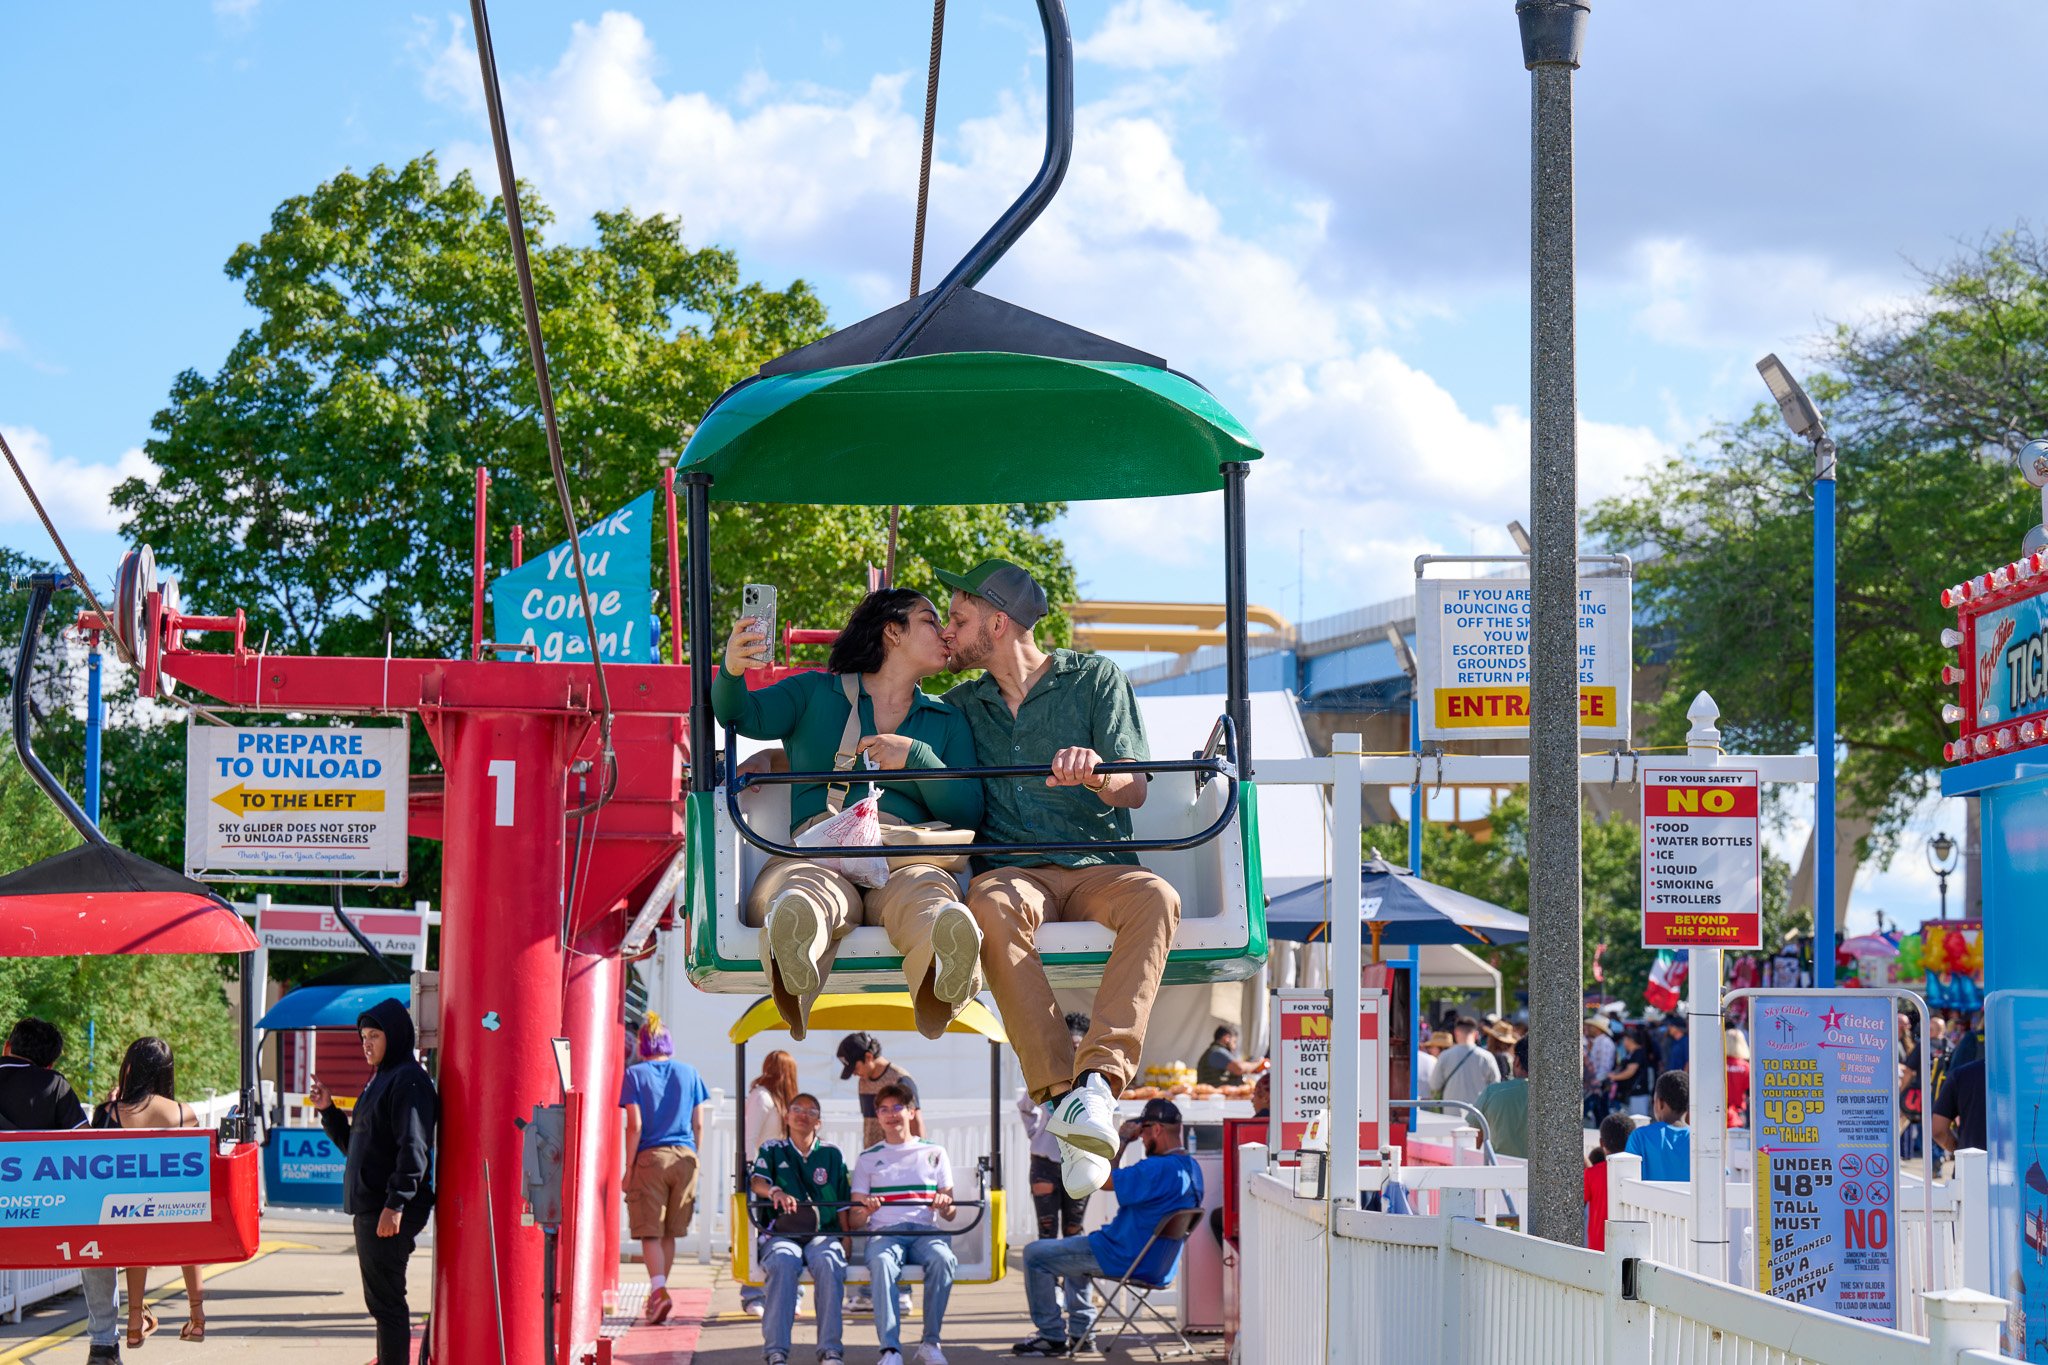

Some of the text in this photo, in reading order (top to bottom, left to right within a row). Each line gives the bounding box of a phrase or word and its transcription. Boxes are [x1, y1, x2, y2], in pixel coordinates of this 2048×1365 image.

[547, 545, 610, 580] You
[1458, 590, 1470, 600] IF
[1473, 590, 1501, 600] YOU
[522, 589, 621, 620] Come
[1444, 604, 1518, 614] BOUNCING
[1457, 617, 1483, 628] OFF
[1486, 617, 1513, 628] THE
[1484, 631, 1513, 641] YOU
[1453, 645, 1524, 655] ESCORTED
[1457, 659, 1527, 669] GROUNDS
[1458, 672, 1512, 683] RETURN
[238, 733, 363, 755] PREPARE
[216, 757, 382, 779] TO UNLOAD
[1658, 775, 1678, 783] FOR
[1680, 775, 1706, 783] YOUR
[487, 760, 516, 826] 1
[240, 793, 356, 808] TO THE LEFT
[1667, 789, 1735, 813] NO
[218, 823, 377, 833] SKY GLIDER DOES NOT STOP
[1656, 823, 1689, 832] FOOD
[226, 833, 369, 844] TO UNLOAD PASSENGERS
[1656, 836, 1753, 847] WATER BOTTLES
[238, 851, 356, 862] Thank You For Your Cooperation
[1656, 850, 1674, 860] ICE
[1656, 865, 1697, 875] LIQUID
[1656, 880, 1714, 889] SMOKING
[1656, 895, 1721, 904] STROLLERS
[1675, 915, 1729, 925] BEYOND
[1664, 926, 1739, 936] THIS POINT
[386, 939, 416, 950] Area
[1829, 1012, 1885, 1030] 1 ticket
[1828, 1030, 1888, 1050] One Way
[1837, 1052, 1881, 1064] NO MORE THAN
[1762, 1059, 1818, 1070] TO RIDE
[1847, 1064, 1875, 1074] PERSONS
[1300, 1067, 1317, 1076] ICE
[1764, 1072, 1824, 1087] ALONE
[1840, 1074, 1853, 1083] PER
[1300, 1082, 1327, 1090] LIQU
[1762, 1089, 1824, 1098] YOU MUST BE
[1836, 1095, 1889, 1104] FOR YOUR SAFETY
[1763, 1126, 1819, 1143] OR TALLER
[283, 1139, 331, 1157] LAS
[33, 1152, 204, 1181] ANGELES
[1773, 1158, 1833, 1171] UNDER
[282, 1171, 310, 1179] FROM
[0, 1195, 66, 1208] ONSTOP
[1773, 1201, 1818, 1213] TALL
[5, 1208, 40, 1219] MKE
[111, 1203, 155, 1218] MKE
[157, 1209, 205, 1217] AIRPORT
[1774, 1218, 1821, 1230] MUST
[1844, 1208, 1888, 1250] NO
[1774, 1233, 1794, 1253] BE
[56, 1240, 103, 1261] 14
[1767, 1234, 1832, 1268] ACCOMPANIED
[1774, 1256, 1809, 1282] BY A
[1765, 1262, 1834, 1297] RESPONSIBLE
[1840, 1281, 1885, 1289] THE SKY GLIDER
[1840, 1291, 1886, 1299] DOES NOT STOP
[1835, 1301, 1891, 1310] TO LOAD OR UNLOAD
